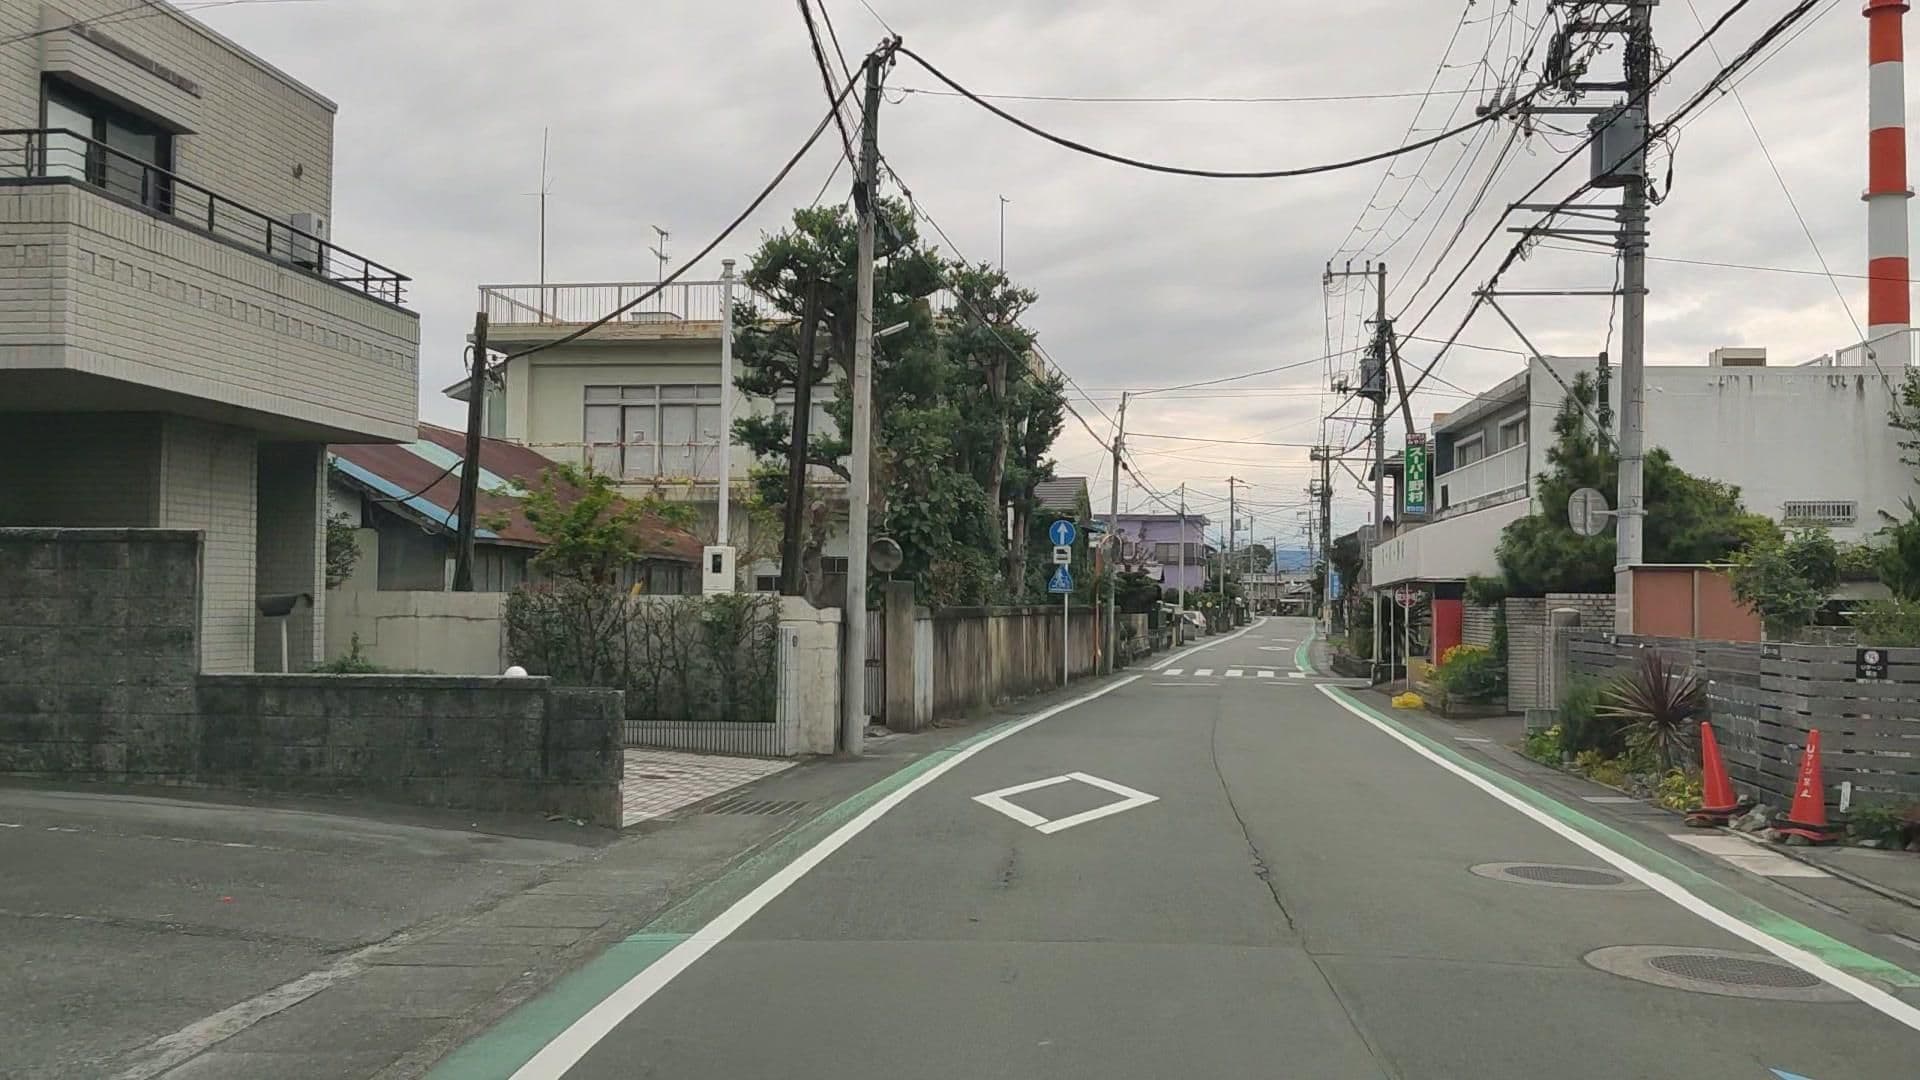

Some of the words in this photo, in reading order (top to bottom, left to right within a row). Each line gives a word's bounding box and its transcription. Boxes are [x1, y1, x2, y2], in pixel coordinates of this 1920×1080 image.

[1408, 447, 1424, 503] スーパー野村
